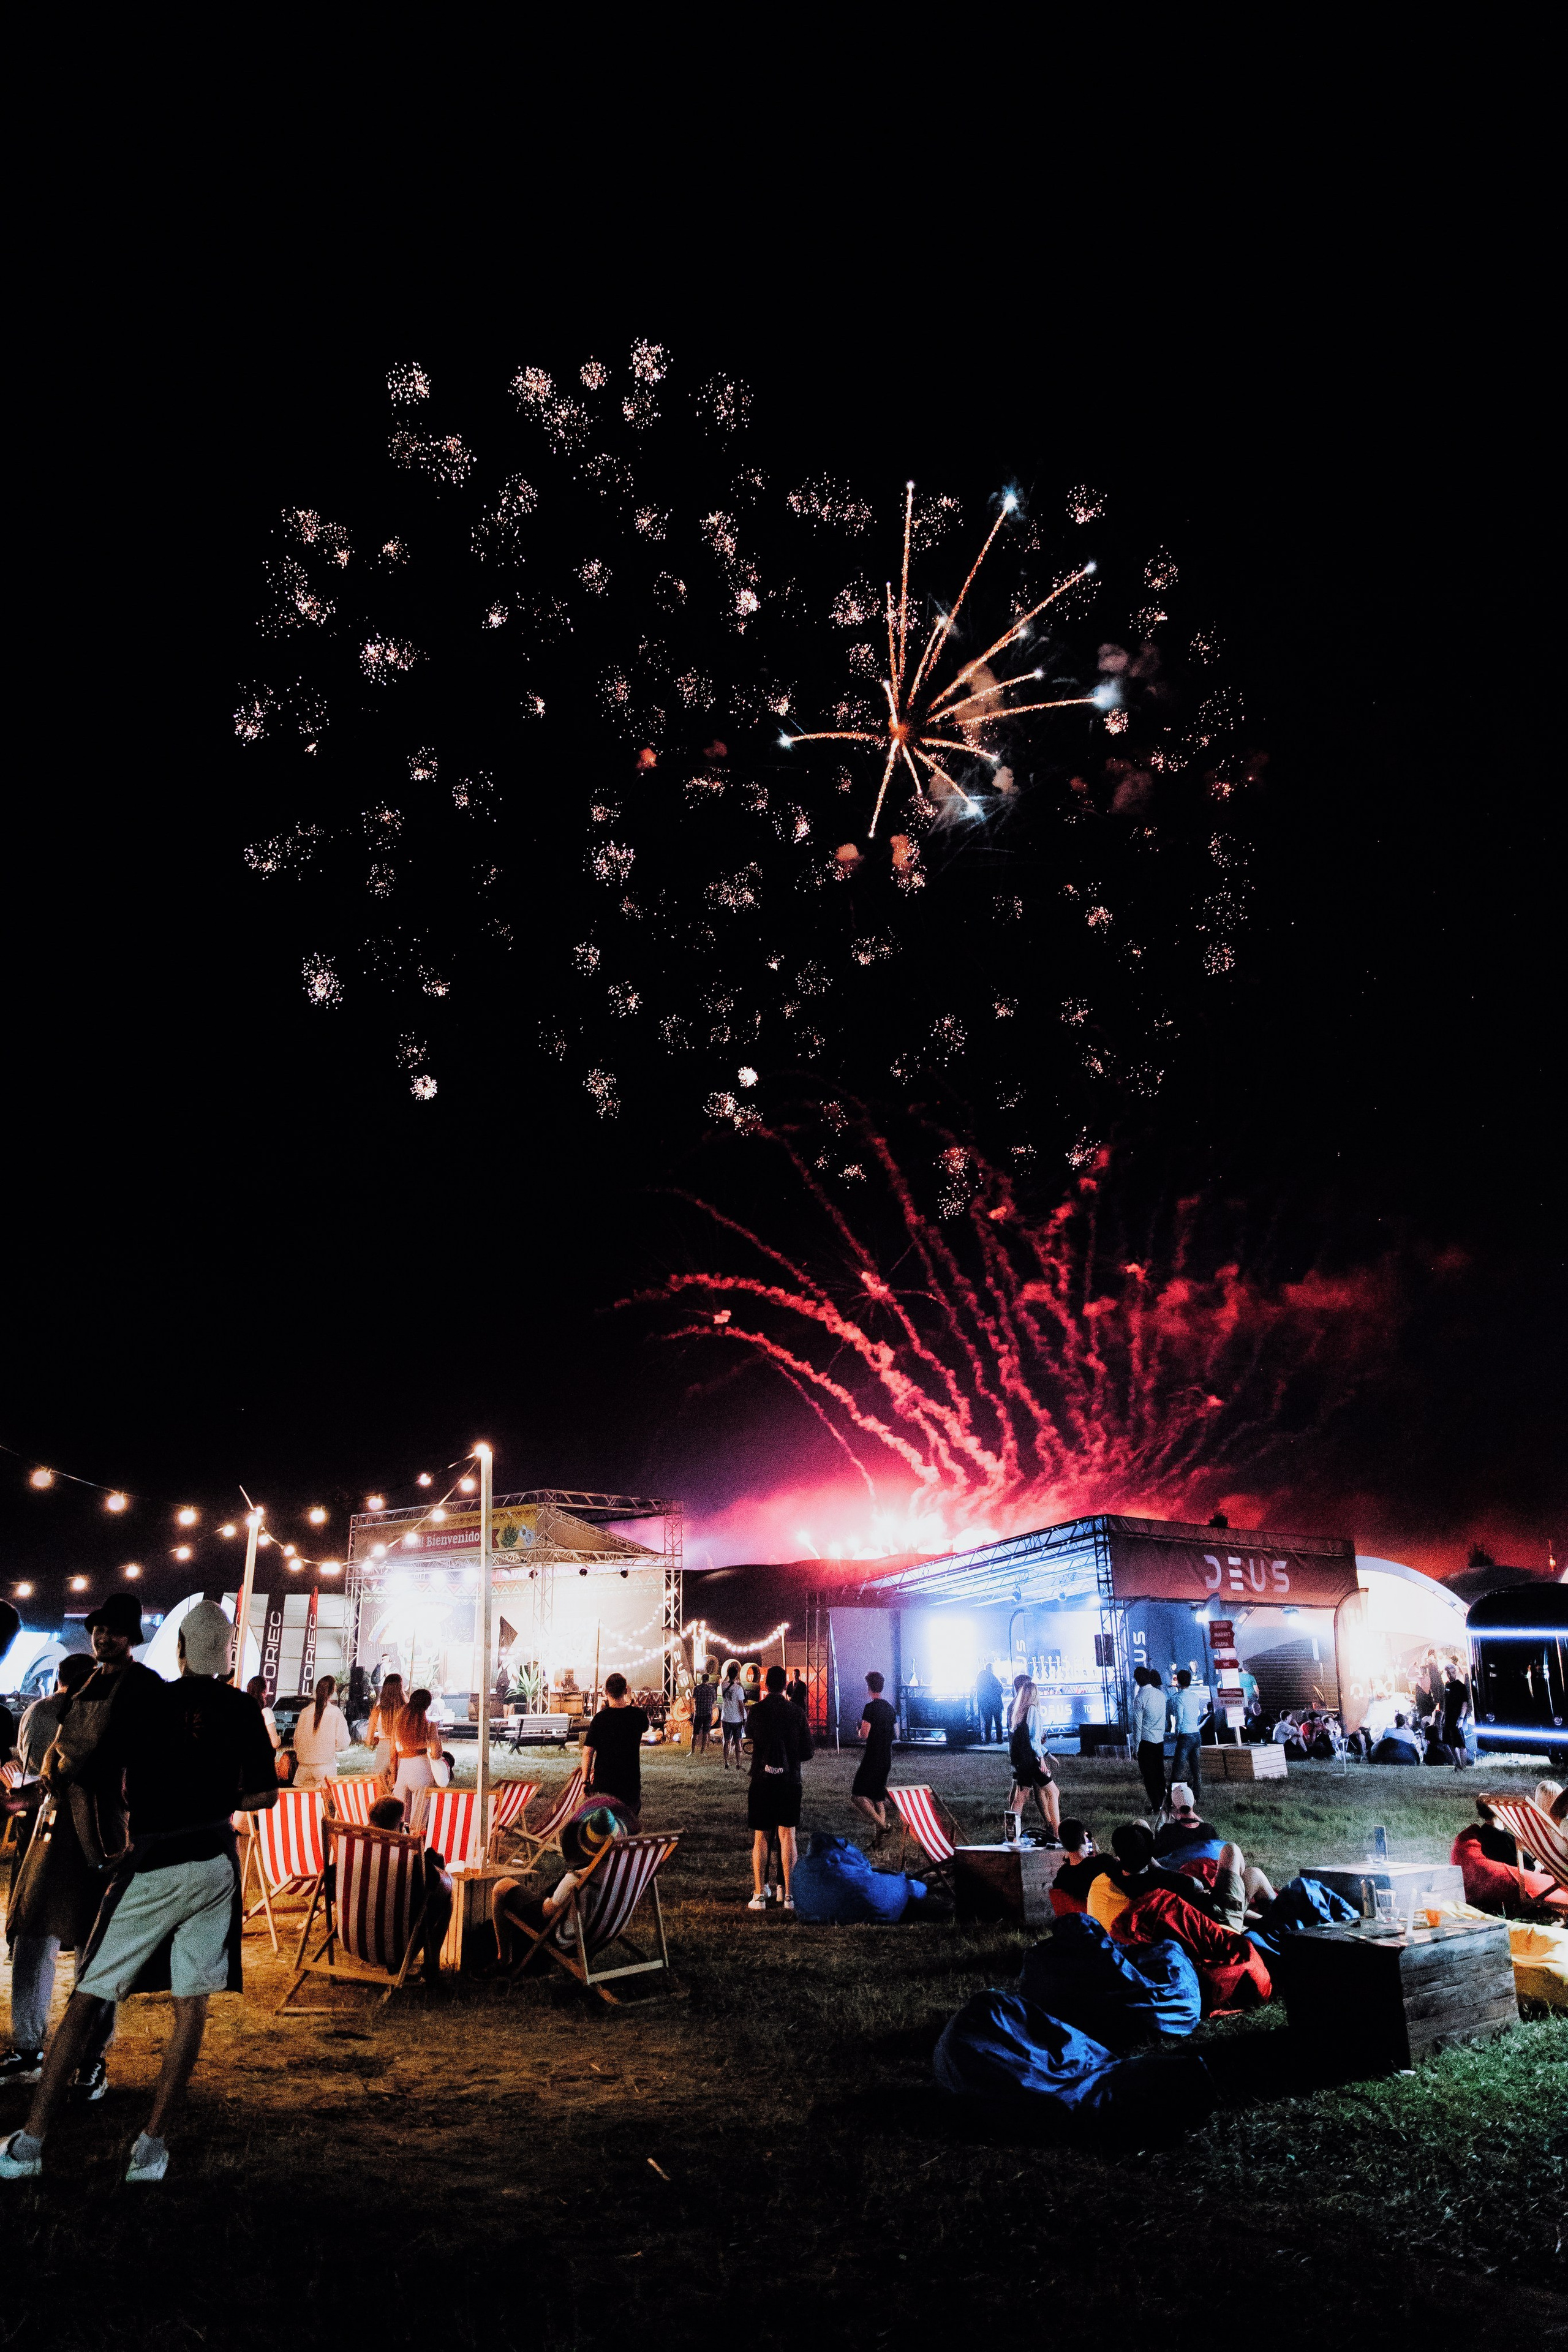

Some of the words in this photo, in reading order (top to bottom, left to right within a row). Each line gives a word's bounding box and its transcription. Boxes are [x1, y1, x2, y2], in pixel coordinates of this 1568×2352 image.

[427, 1531, 481, 1547] Bienvenido
[1204, 1555, 1290, 1593] DEUS
[302, 1613, 317, 1695] FORIEC
[1040, 1704, 1072, 1717] DEUS
